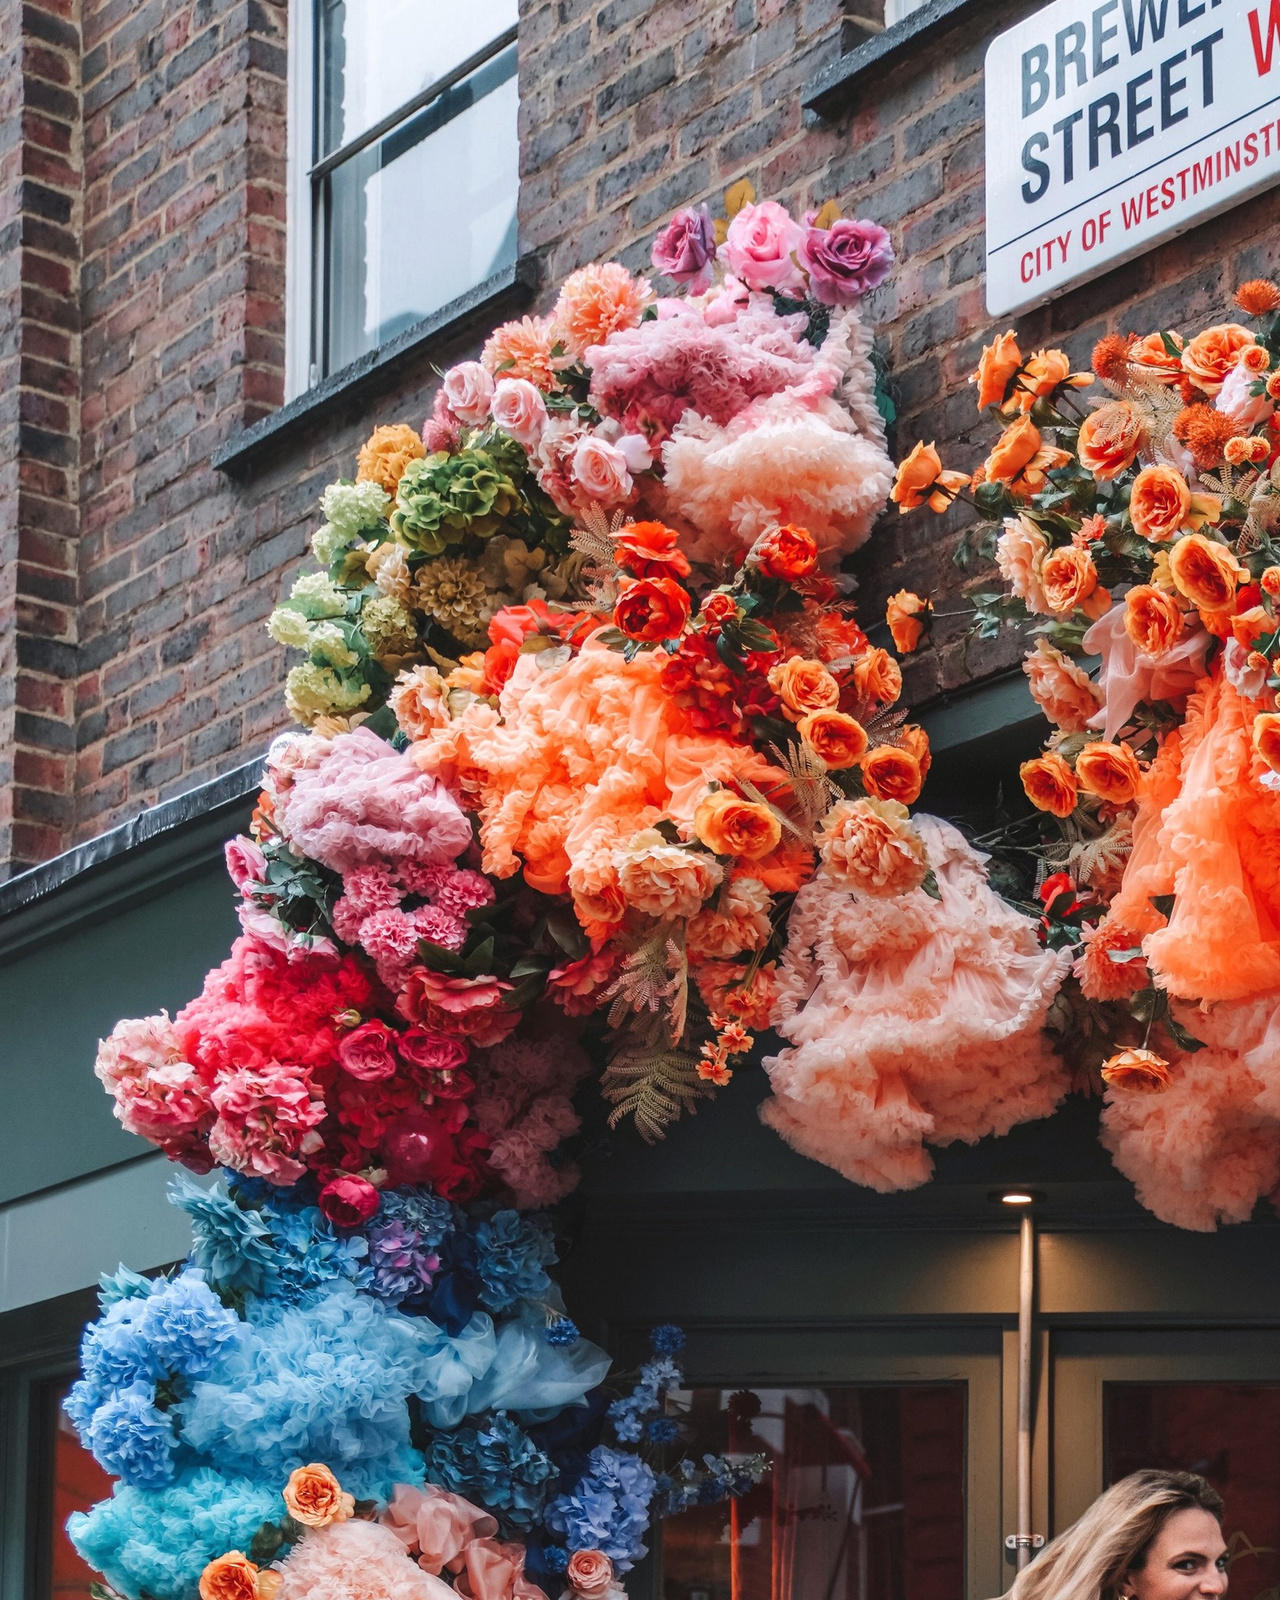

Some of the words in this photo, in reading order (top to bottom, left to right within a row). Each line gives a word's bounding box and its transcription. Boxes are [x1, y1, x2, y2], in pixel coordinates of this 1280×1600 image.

[1020, 27, 1224, 204] STREET
[1021, 0, 1222, 120] BREW
[1020, 231, 1071, 284] CITY
[1081, 210, 1111, 252] OF
